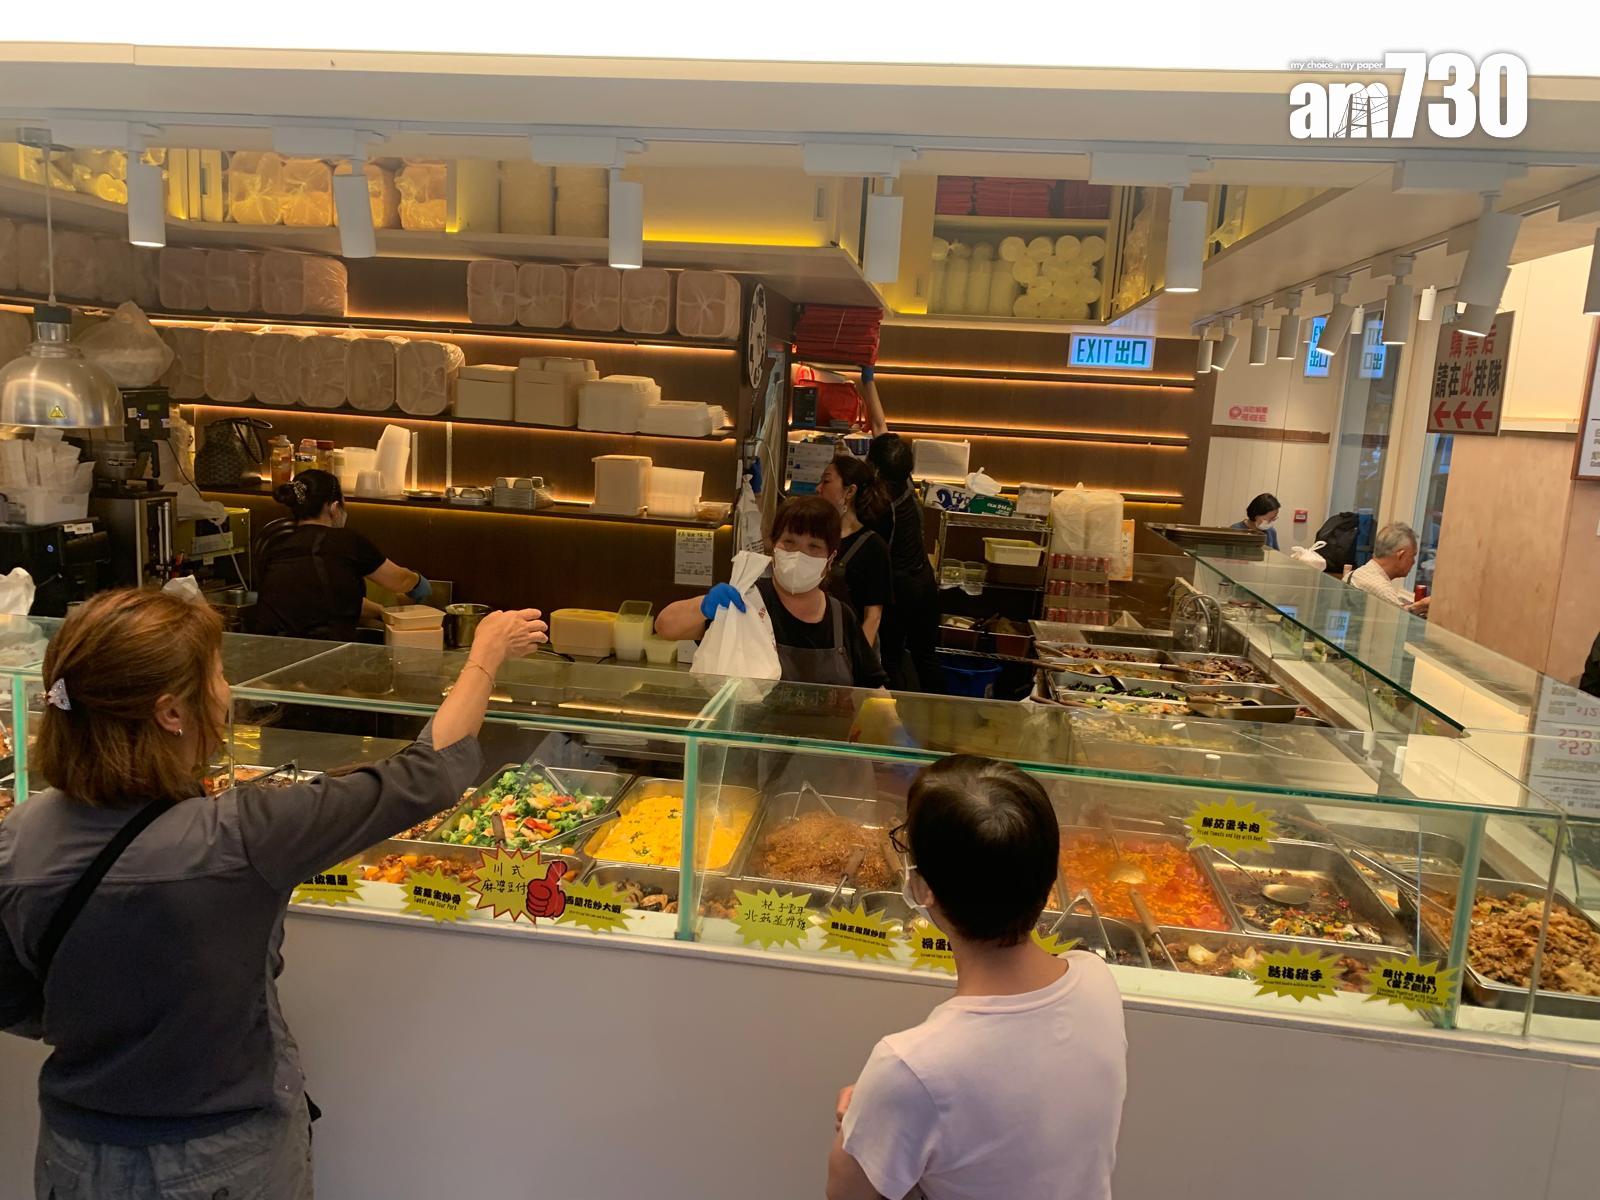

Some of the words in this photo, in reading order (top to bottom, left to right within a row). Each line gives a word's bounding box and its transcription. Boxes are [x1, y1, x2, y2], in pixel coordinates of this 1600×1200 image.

[1077, 338, 1112, 363] EXIT
[1115, 340, 1147, 365] 出口
[1434, 360, 1502, 398] 請在此排隊
[493, 862, 525, 879] 川式
